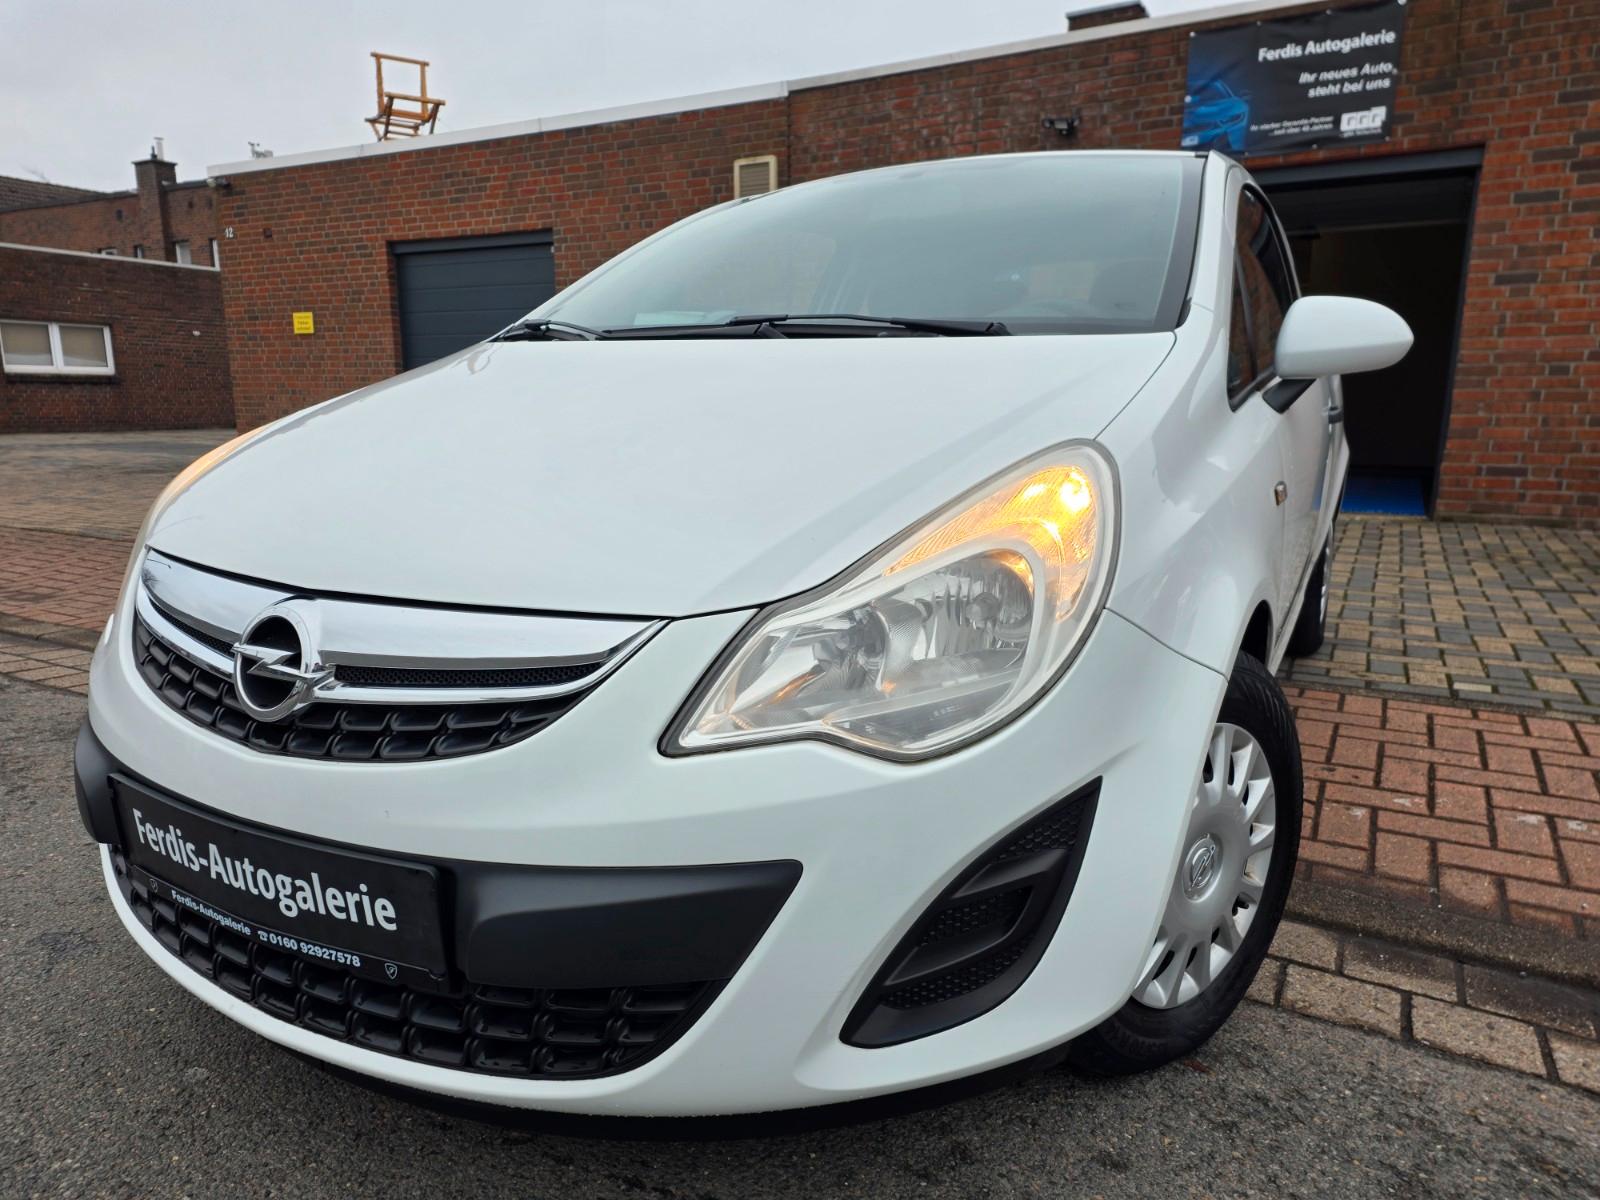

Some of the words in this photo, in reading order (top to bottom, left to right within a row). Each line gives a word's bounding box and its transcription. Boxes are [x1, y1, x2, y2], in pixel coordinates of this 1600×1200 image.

[1258, 43, 1303, 62] Ferdis
[1304, 29, 1396, 55] Autogalerie
[1299, 71, 1318, 84] Ihr
[1319, 67, 1358, 81] neues
[1308, 83, 1342, 98] steht
[1342, 79, 1364, 94] bei
[1365, 78, 1391, 91] uns
[132, 807, 398, 932] Ferdis-Autogalerie
[171, 889, 252, 936] Ferdis-Autogalerie
[269, 933, 299, 951] 0160
[300, 941, 361, 968] 92927578
